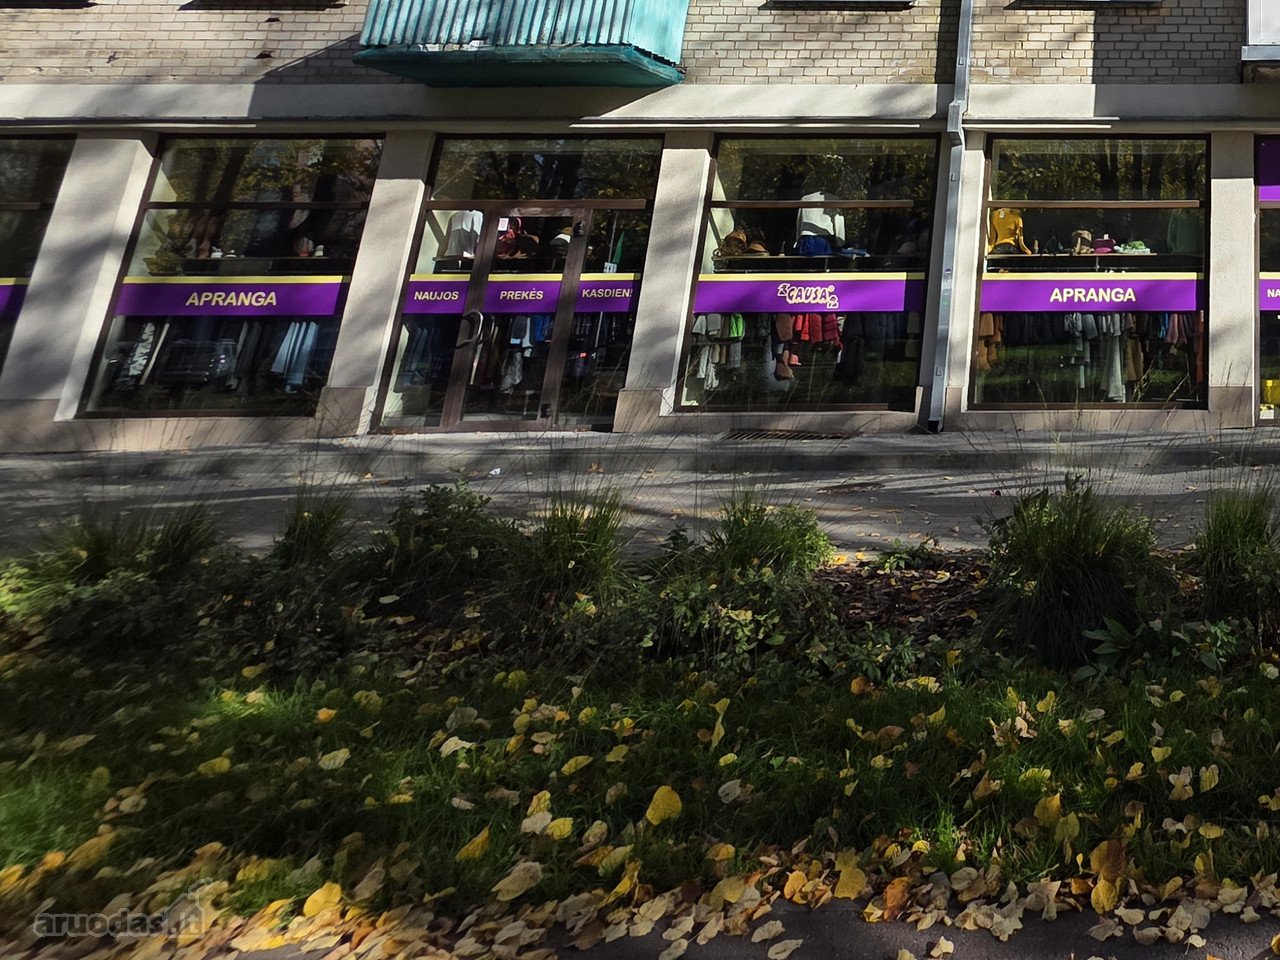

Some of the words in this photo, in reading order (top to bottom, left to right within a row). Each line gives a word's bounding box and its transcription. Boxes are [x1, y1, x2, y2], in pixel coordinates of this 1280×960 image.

[185, 291, 277, 306] APRANGA
[414, 291, 459, 300] NAUJOS
[500, 287, 544, 300] PREKĖS
[582, 288, 633, 298] KASDIEN!
[1049, 287, 1136, 303] APRANGA
